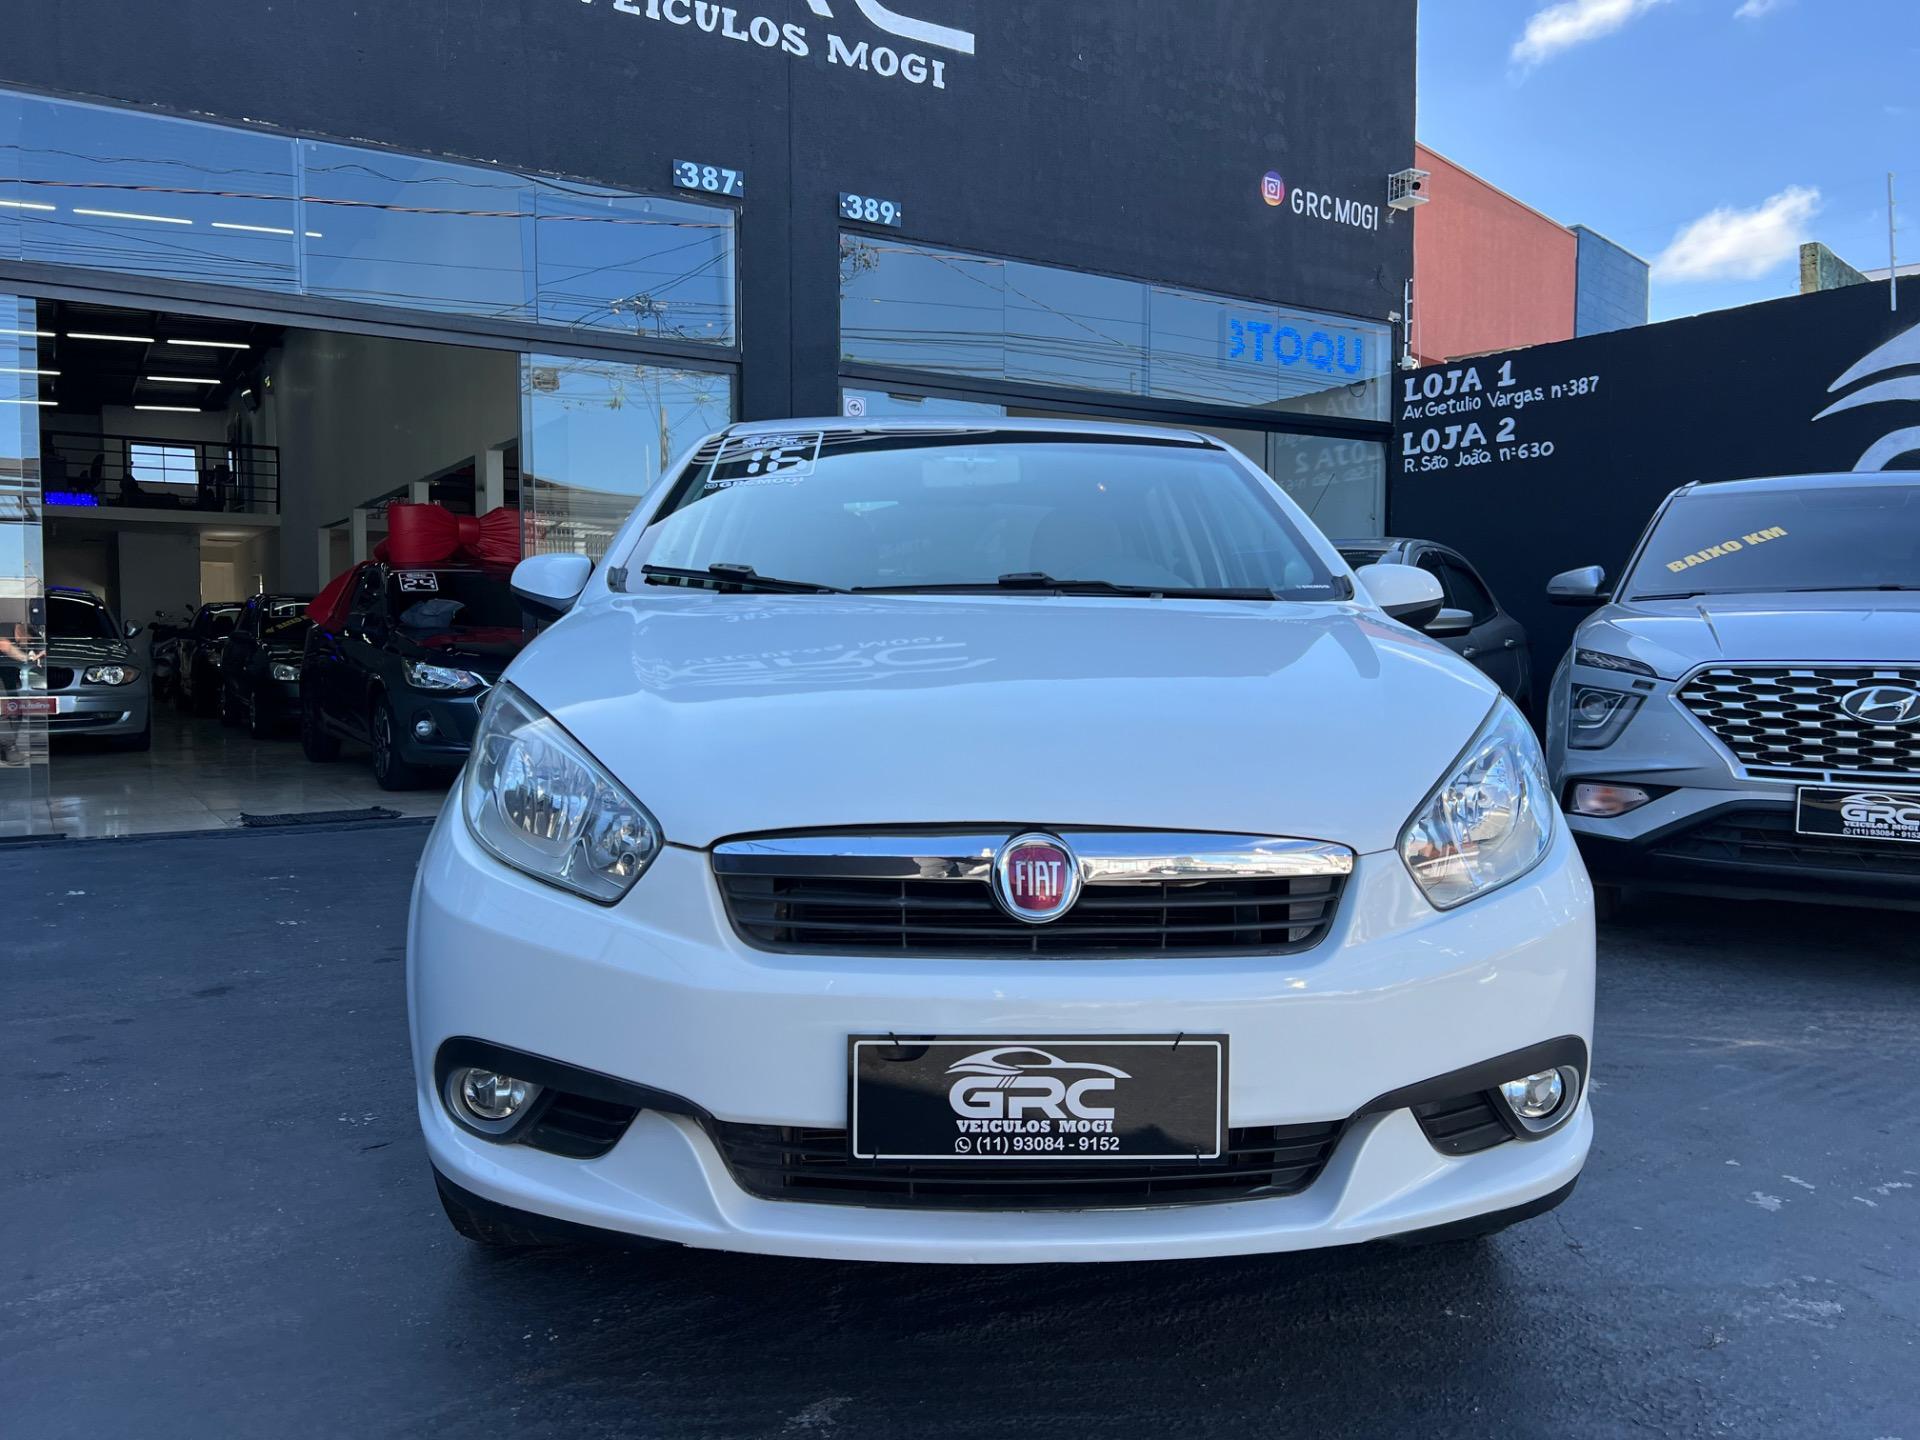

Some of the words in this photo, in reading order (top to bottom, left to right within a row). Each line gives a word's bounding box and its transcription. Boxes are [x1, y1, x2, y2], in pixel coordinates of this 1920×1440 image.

[827, 34, 945, 89] MOGI
[681, 162, 736, 194] 387
[846, 195, 894, 224] 389
[1291, 187, 1378, 231] GRCMOGI
[1404, 367, 1482, 402] LOJA
[1497, 360, 1516, 387] 1
[1425, 398, 1481, 417] Getulio
[1403, 422, 1487, 455] LOJA
[1496, 417, 1515, 443] 2
[1666, 540, 1743, 573] BAIXO
[1742, 526, 1788, 546] KM
[404, 579, 436, 590] 24
[1841, 803, 1920, 827] GRC
[1843, 821, 1889, 830] VEICULOS
[1891, 824, 1919, 832] MOGI
[1853, 828, 1868, 836] (11)
[1870, 829, 1895, 837] 93084
[1015, 860, 1061, 896] FIAT
[949, 1076, 1115, 1119] GRC
[956, 1120, 1050, 1133] VEICULOS
[1058, 1120, 1113, 1133] MOGI
[976, 1136, 1009, 1154] (11)
[1013, 1137, 1065, 1151] 93084
[1079, 1137, 1120, 1151] 9152
